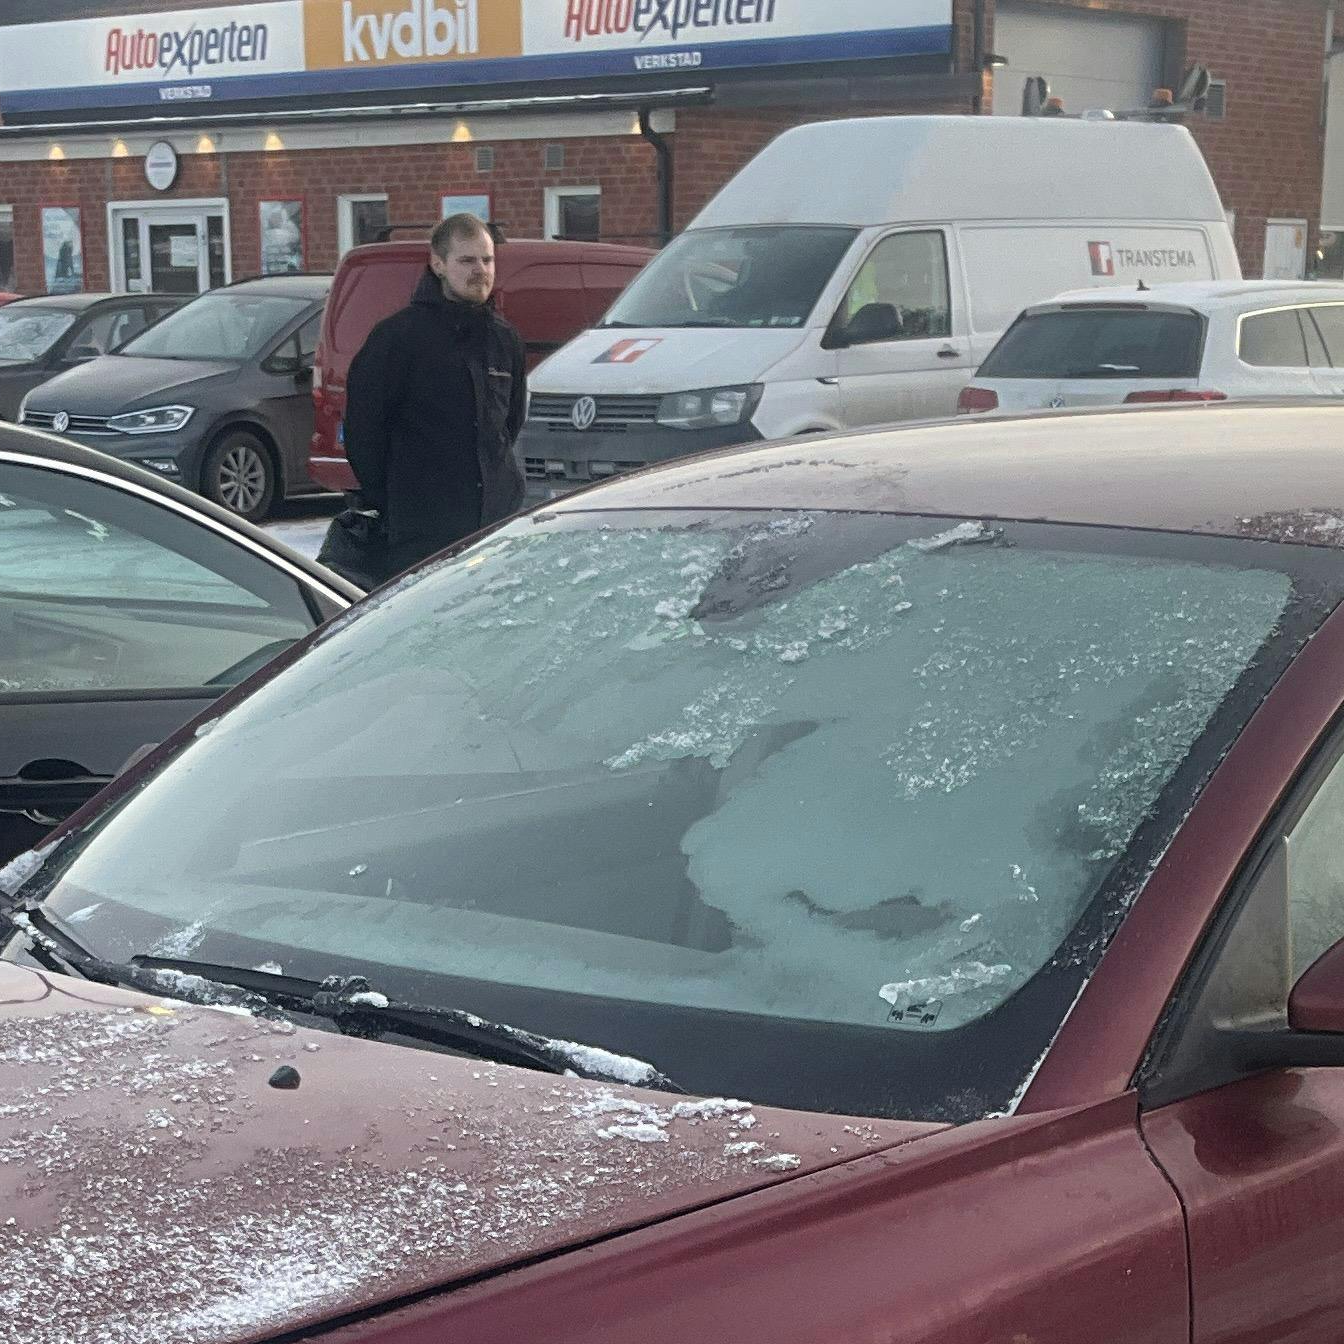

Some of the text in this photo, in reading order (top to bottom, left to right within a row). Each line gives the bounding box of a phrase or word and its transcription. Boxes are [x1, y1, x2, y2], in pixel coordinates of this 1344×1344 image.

[105, 21, 267, 76] Autoexperten
[343, 0, 478, 62] kvdbil
[634, 52, 702, 70] VERKSTAD
[1117, 249, 1196, 268] TRANSTEMA
